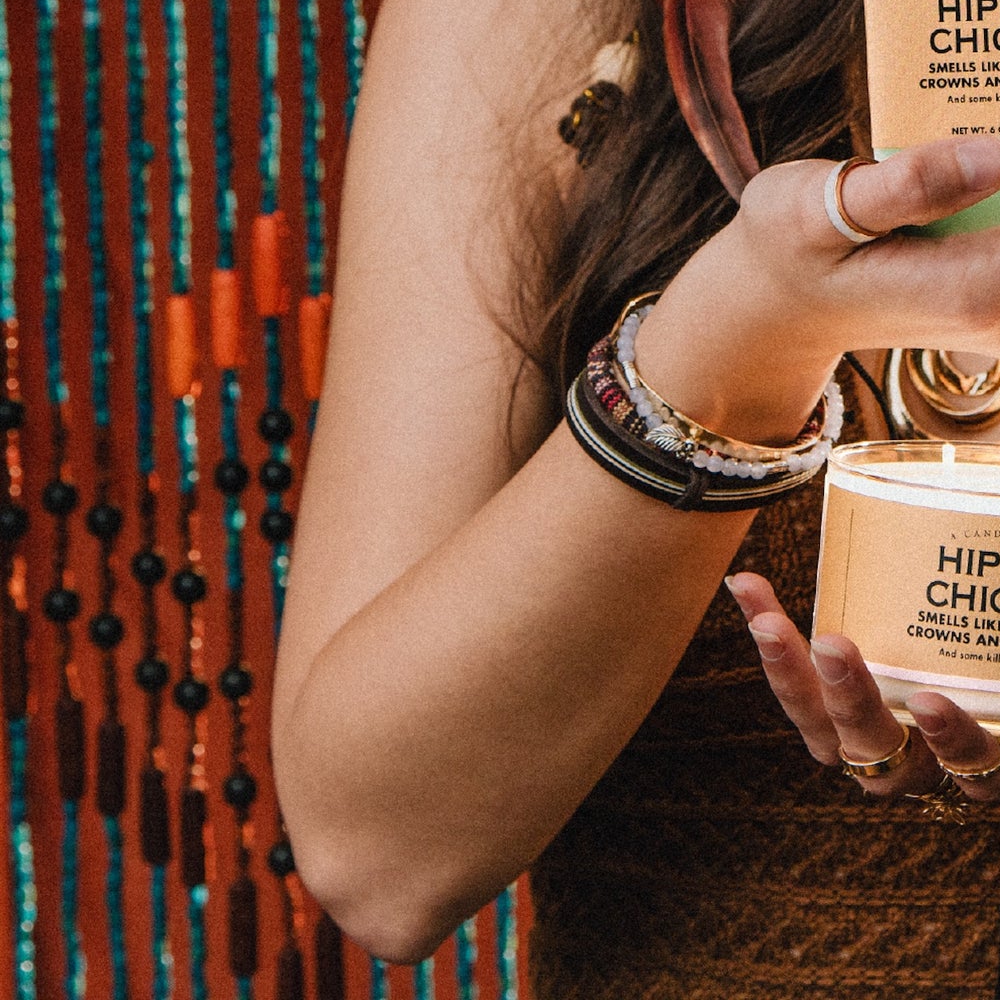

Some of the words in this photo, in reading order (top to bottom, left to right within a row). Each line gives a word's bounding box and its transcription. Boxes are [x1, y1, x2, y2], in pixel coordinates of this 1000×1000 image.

[929, 62, 976, 73] SMELLS
[920, 77, 980, 89] CROWNS
[947, 95, 966, 103] And
[952, 127, 968, 135] NET
[971, 126, 987, 134] WT.
[918, 611, 969, 627] SMELLS
[907, 626, 970, 643] CROWNS
[939, 648, 956, 658] And
[960, 652, 984, 661] some
